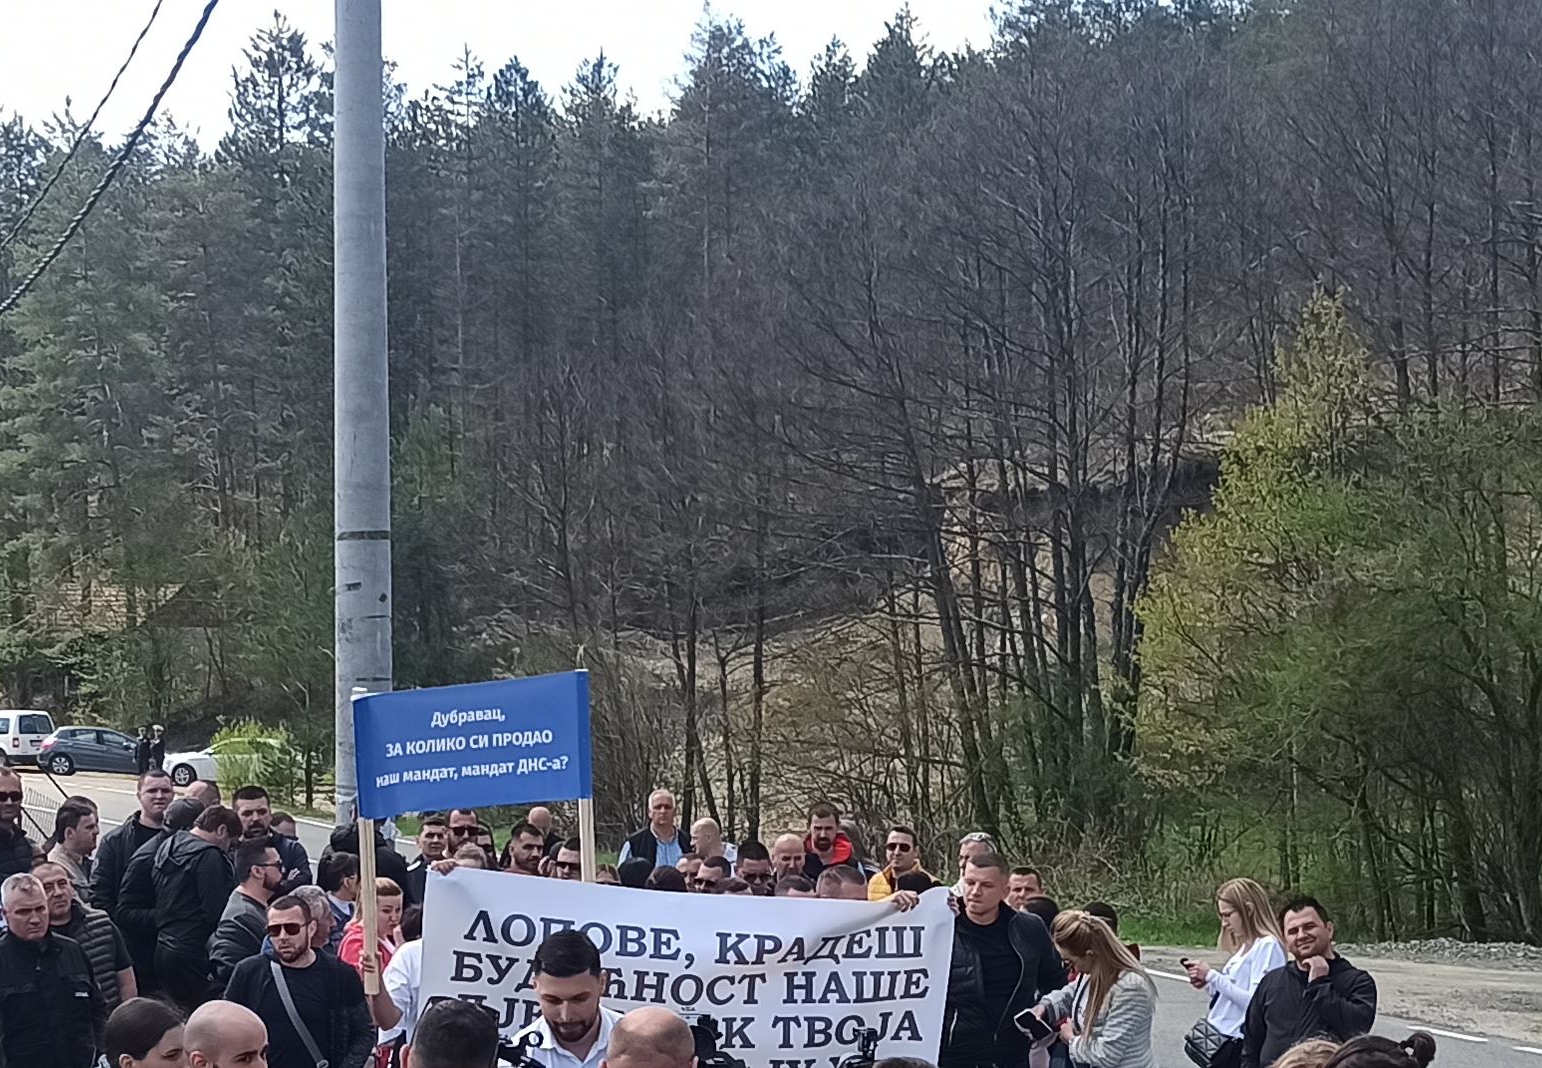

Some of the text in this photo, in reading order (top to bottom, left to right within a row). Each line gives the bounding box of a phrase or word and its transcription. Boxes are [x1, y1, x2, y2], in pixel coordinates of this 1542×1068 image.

[431, 707, 506, 728] Дубравац,
[386, 729, 553, 758] ЗА КОЛИКО СИ ПРОДАО
[376, 755, 569, 788] наш мандат, мандат ДНС-а?
[714, 926, 925, 966] КРАДЕШ
[450, 950, 930, 1006] БУЋНОСТ НАШЕ
[771, 1010, 924, 1049] ТВОЈА
